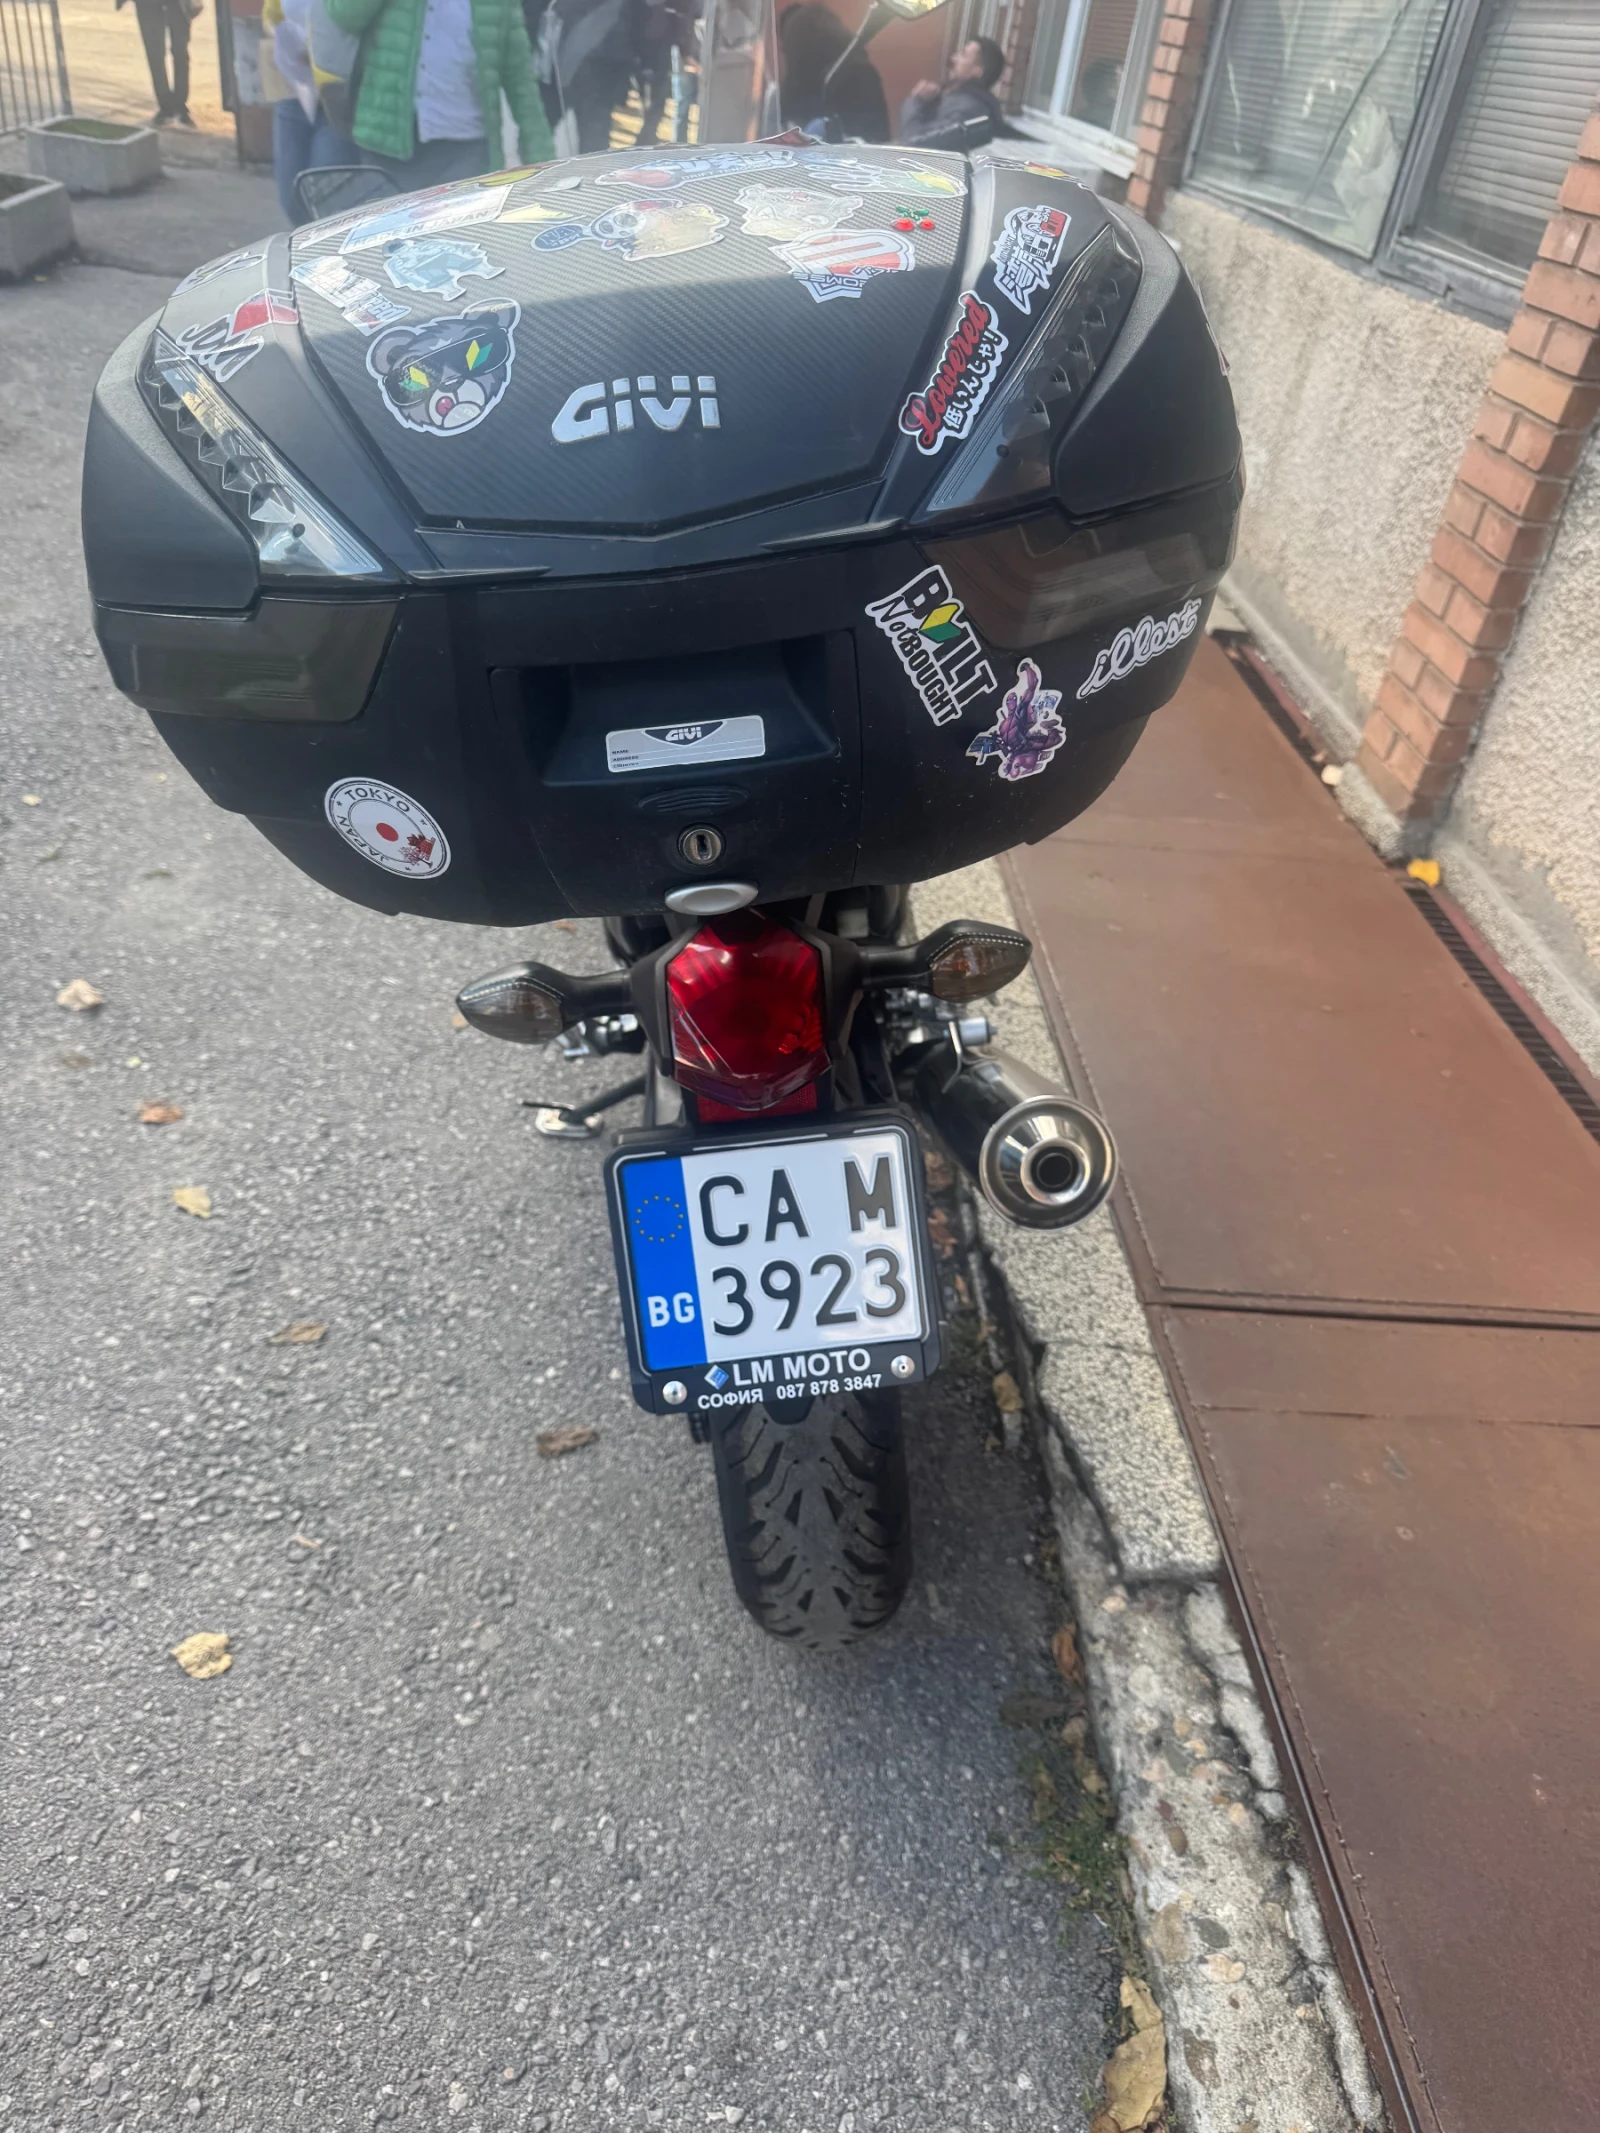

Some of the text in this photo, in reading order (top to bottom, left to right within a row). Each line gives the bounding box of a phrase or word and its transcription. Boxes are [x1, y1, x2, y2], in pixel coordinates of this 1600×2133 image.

[405, 223, 425, 234] IN
[428, 210, 489, 229] JAPAN
[905, 294, 989, 445] Lowered
[1079, 600, 1201, 698] illest
[899, 636, 959, 724] BOUGHT
[665, 726, 702, 742] GIVI
[344, 787, 411, 813] TOKYO
[336, 814, 391, 862] JAPAN
[698, 1156, 897, 1247] CA M
[646, 1291, 696, 1328] BG
[711, 1248, 907, 1336] 3923
[732, 1348, 871, 1387] LM MOTO
[697, 1373, 882, 1410] СОФИЯ 087 878 3847
